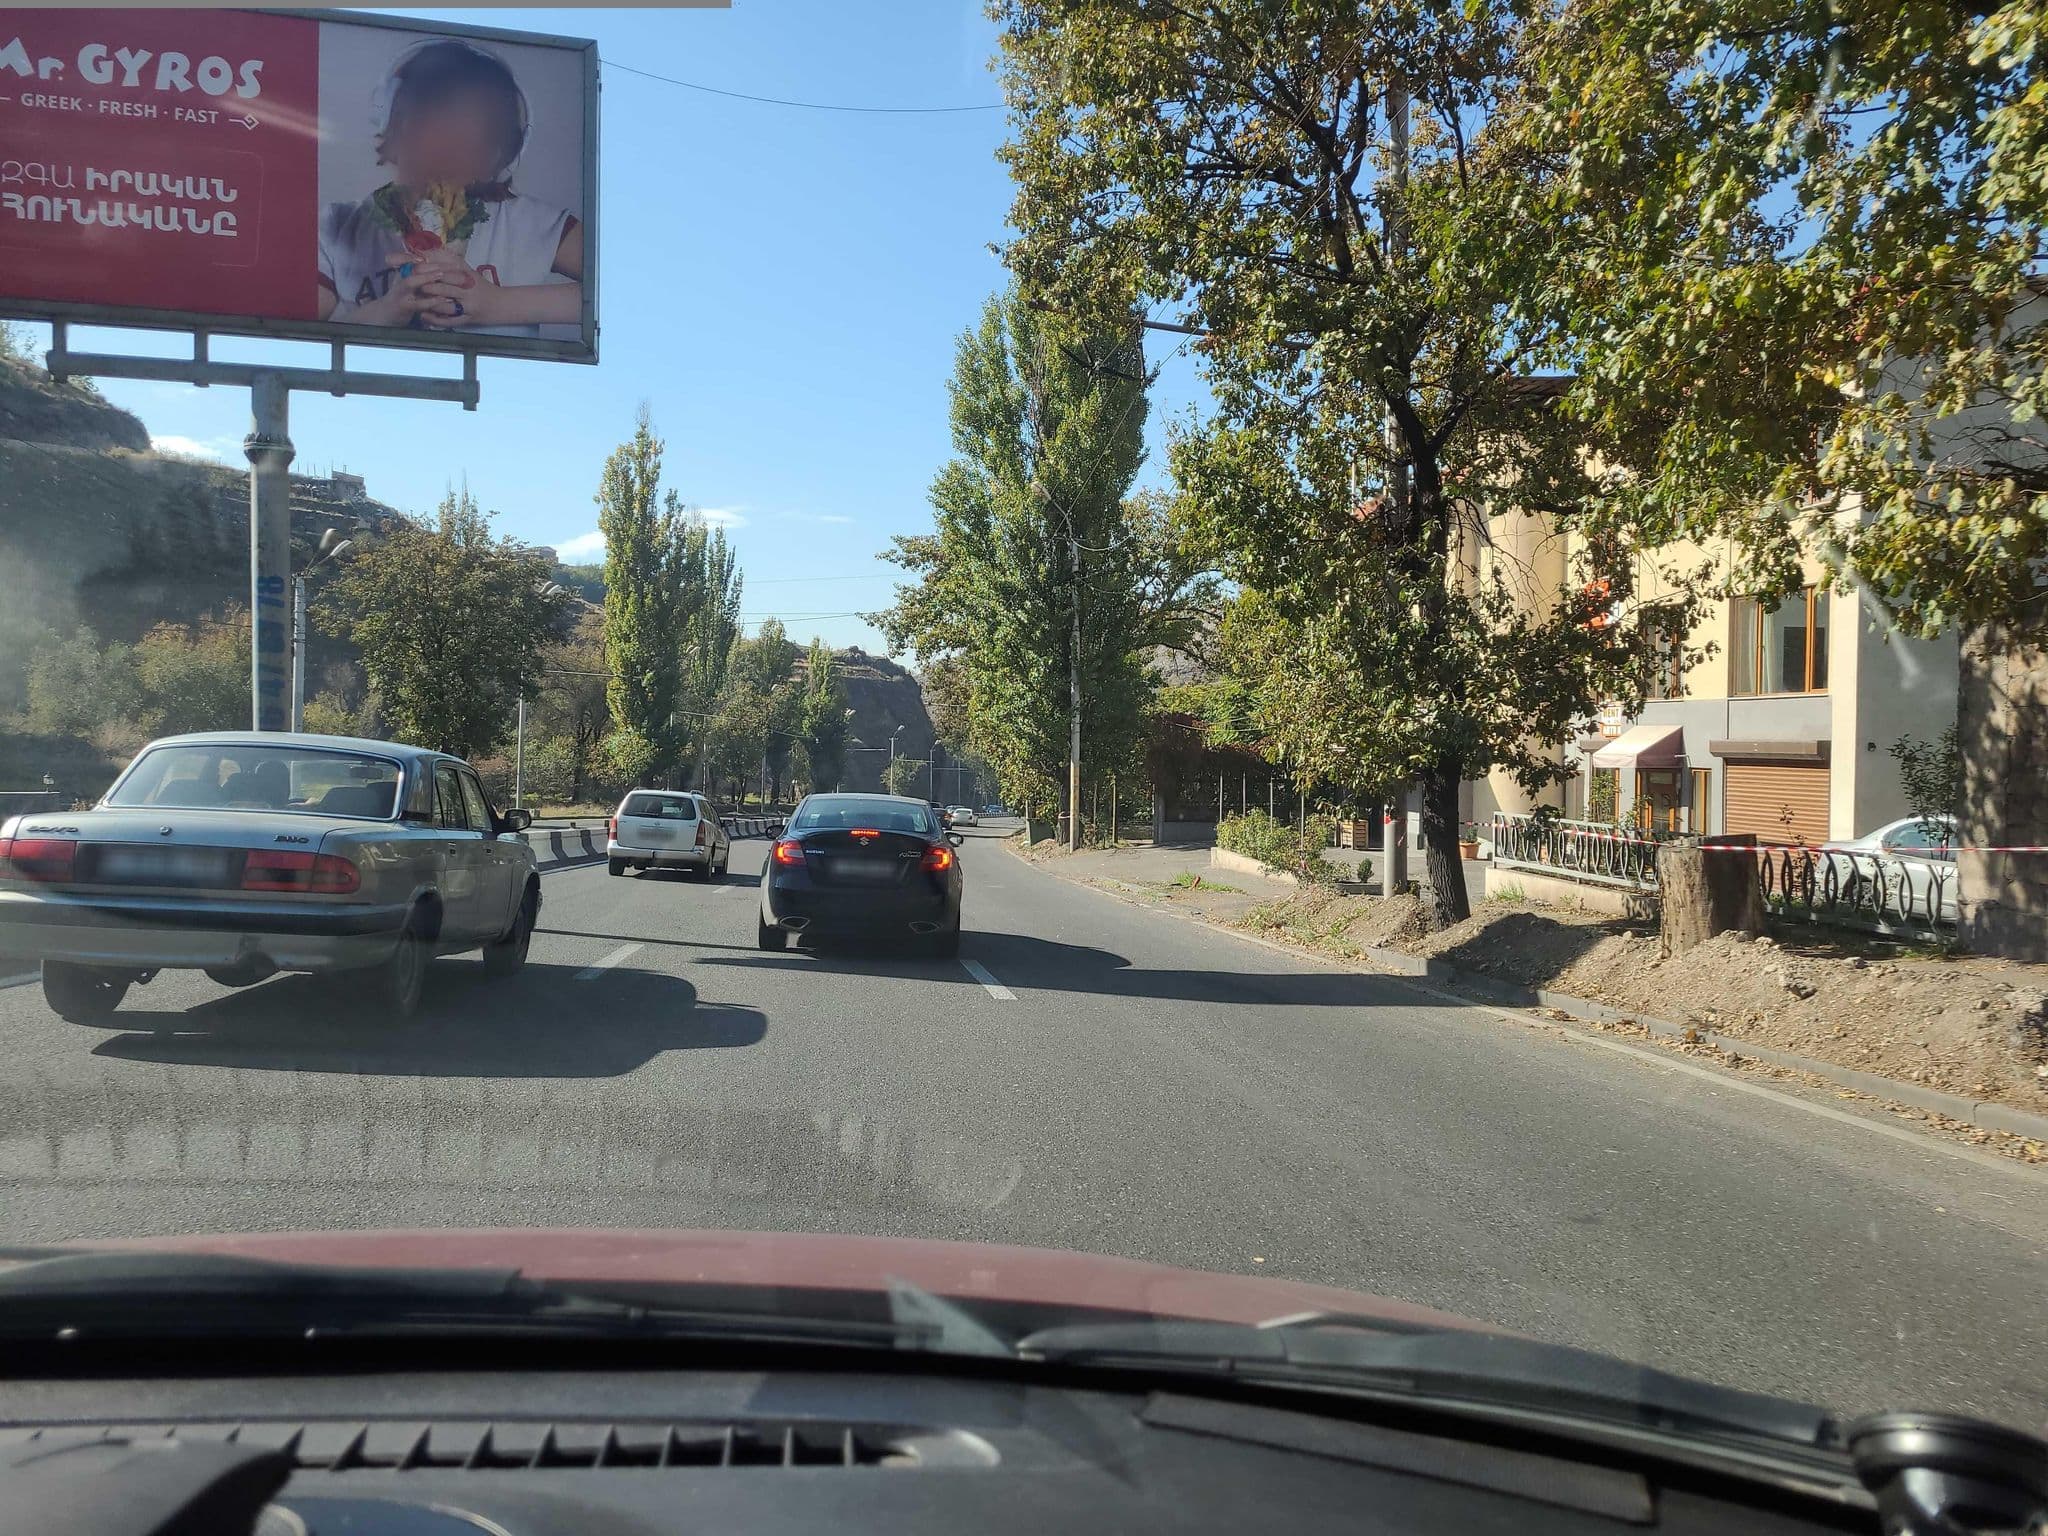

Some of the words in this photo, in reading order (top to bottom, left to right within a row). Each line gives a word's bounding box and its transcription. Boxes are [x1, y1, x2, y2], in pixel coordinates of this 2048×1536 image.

[77, 43, 264, 98] GYROS
[21, 93, 82, 111] GREEK
[100, 100, 157, 118] FRESH
[175, 107, 219, 124] FAST
[86, 167, 238, 203] ԻՐԱԿԱՆ
[2, 192, 238, 237] ՀՈՒՆԱԿԱՆԸ
